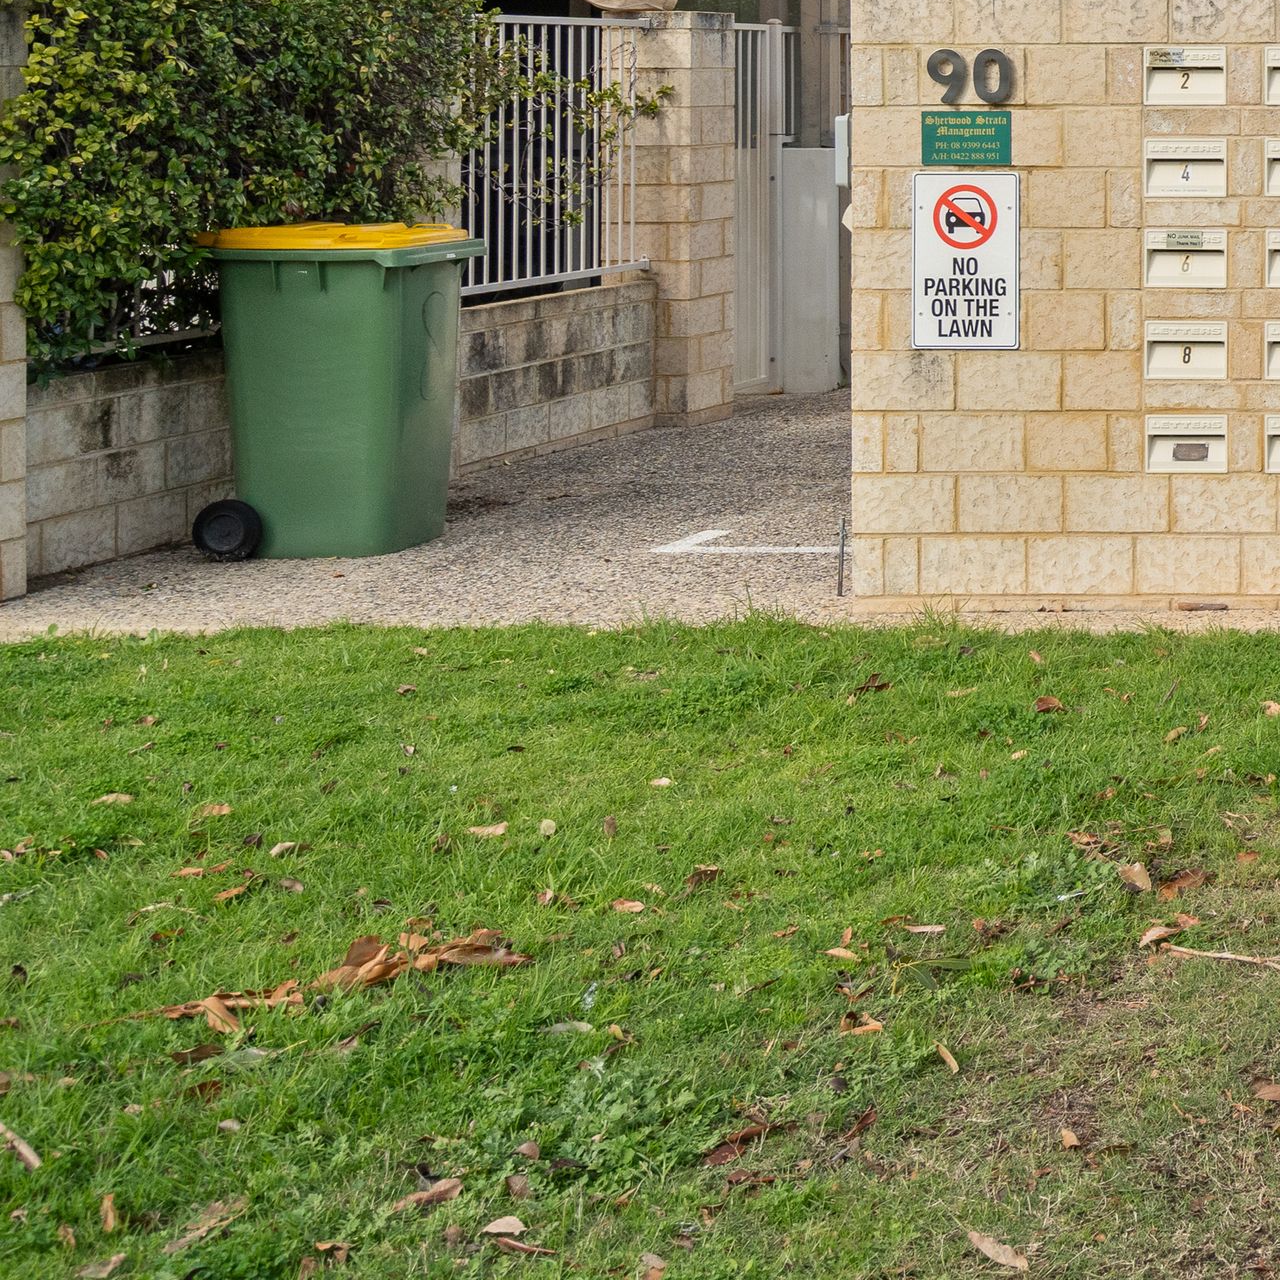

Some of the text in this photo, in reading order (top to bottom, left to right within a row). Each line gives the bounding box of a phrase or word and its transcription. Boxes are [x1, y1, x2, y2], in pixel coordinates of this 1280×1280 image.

[926, 48, 1011, 104] 90
[1180, 72, 1190, 90] 2
[925, 115, 972, 125] Sherwood
[936, 126, 996, 137] Management
[935, 141, 1001, 150] PH: 08 9399 6443
[931, 152, 1000, 160] A/H: 0422 888 951
[1181, 164, 1190, 182] 4
[953, 257, 978, 276] NO
[1181, 255, 1190, 272] 6
[924, 278, 1007, 296] PARKING
[931, 298, 1000, 317] ON THE
[938, 319, 992, 338] LAWN
[1182, 346, 1192, 364] 8
